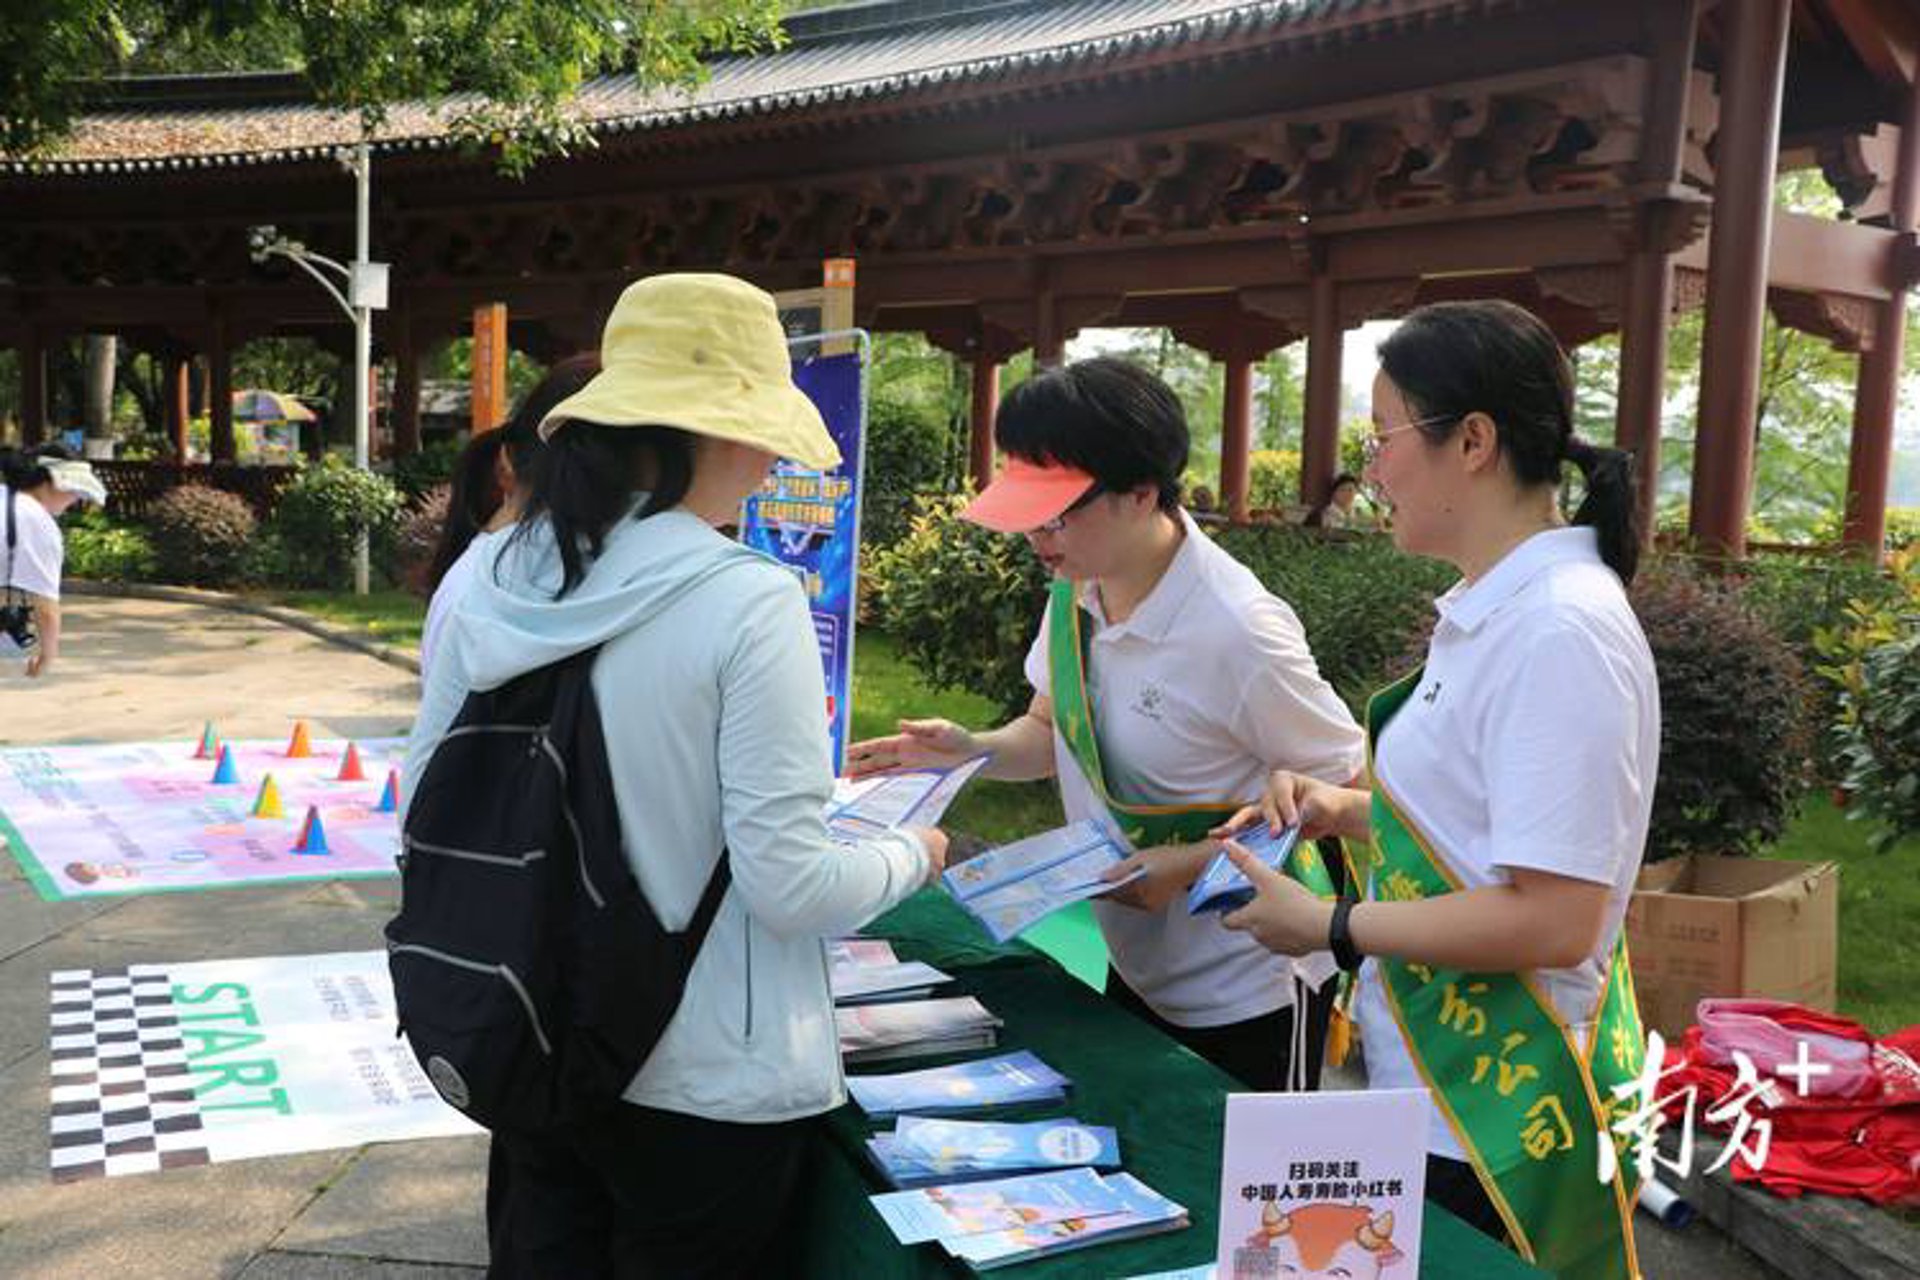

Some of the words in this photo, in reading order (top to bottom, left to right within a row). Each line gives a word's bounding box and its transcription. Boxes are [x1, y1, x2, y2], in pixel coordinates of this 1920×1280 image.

[171, 983, 293, 1115] START
[1289, 1161, 1360, 1181] 扫码关注
